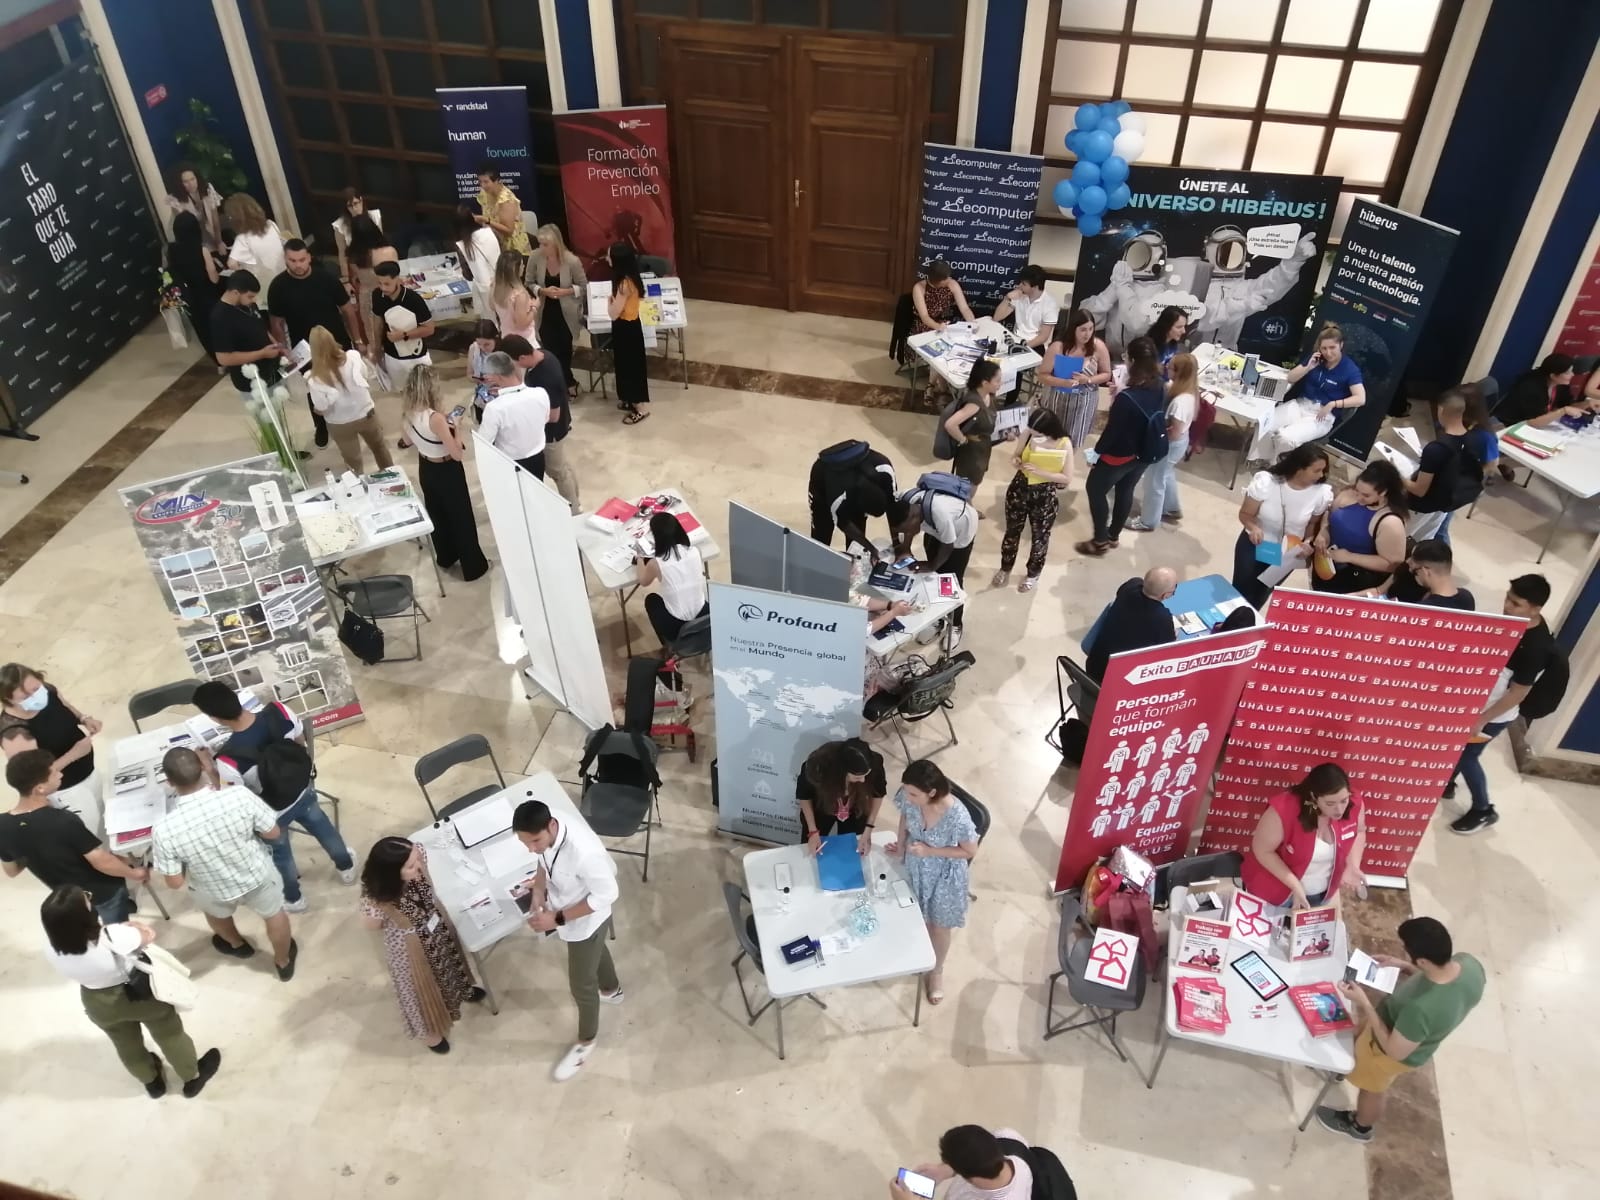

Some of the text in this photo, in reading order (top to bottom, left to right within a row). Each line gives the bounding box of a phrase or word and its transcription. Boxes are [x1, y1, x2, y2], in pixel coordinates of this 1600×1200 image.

[456, 102, 488, 111] randstad
[447, 130, 487, 141] human
[587, 145, 657, 161] Formación
[955, 158, 1002, 170] ecomputer
[20, 162, 39, 186] EL
[588, 163, 659, 180] Prevención
[611, 181, 660, 198] Empleo
[1179, 178, 1249, 194] ÚNETE AL
[26, 182, 57, 216] FARO
[1124, 193, 1215, 213] NIVERSO
[963, 203, 1034, 220] ecomputer
[1360, 208, 1398, 231] hiberus
[35, 204, 70, 243] QUE TE
[49, 231, 77, 263] GUÍA
[1348, 240, 1416, 274] Une tu talento
[947, 260, 1011, 275] computer
[1343, 255, 1424, 292] a nuestra pasión
[1338, 267, 1355, 280] por
[1357, 272, 1366, 283] la
[1368, 277, 1421, 306] tecnología.
[767, 611, 838, 633] Profand
[1287, 601, 1355, 616] BAUHAUS
[1360, 611, 1429, 626] BAUHAUS
[1435, 620, 1505, 635] BAUHAUS
[730, 636, 846, 662] Nuestra Presencia global
[1315, 627, 1383, 643] BAUHAUS
[1388, 637, 1458, 652] BAUHAUS
[748, 647, 785, 659] Mundo
[1140, 645, 1257, 679] Éxito BAUHAUS
[1274, 644, 1484, 675] BAUHAUS BAUHAUS BAUHAUS
[1301, 668, 1368, 683] BAUHAUS
[1372, 677, 1439, 692] BAUHAUS
[1115, 689, 1186, 711] Personas
[1261, 684, 1466, 714] BAUHAUS BAUHAUS BAUHAUS
[1112, 697, 1197, 725] que forman
[1288, 707, 1353, 721] BAUHAUS
[1358, 716, 1423, 730] BAUHAUS
[1109, 719, 1166, 737] equipo.
[1249, 722, 1449, 751] BAUHAUS BAUHAUS BAUHAUS
[1276, 744, 1338, 758] BAUHAUS
[1343, 753, 1407, 766] BAUHAUS
[1238, 758, 1299, 771] BAUHAUS
[1370, 773, 1432, 786] BAUHAUS
[1135, 821, 1182, 838] Equipo
[1139, 833, 1177, 847] forma
